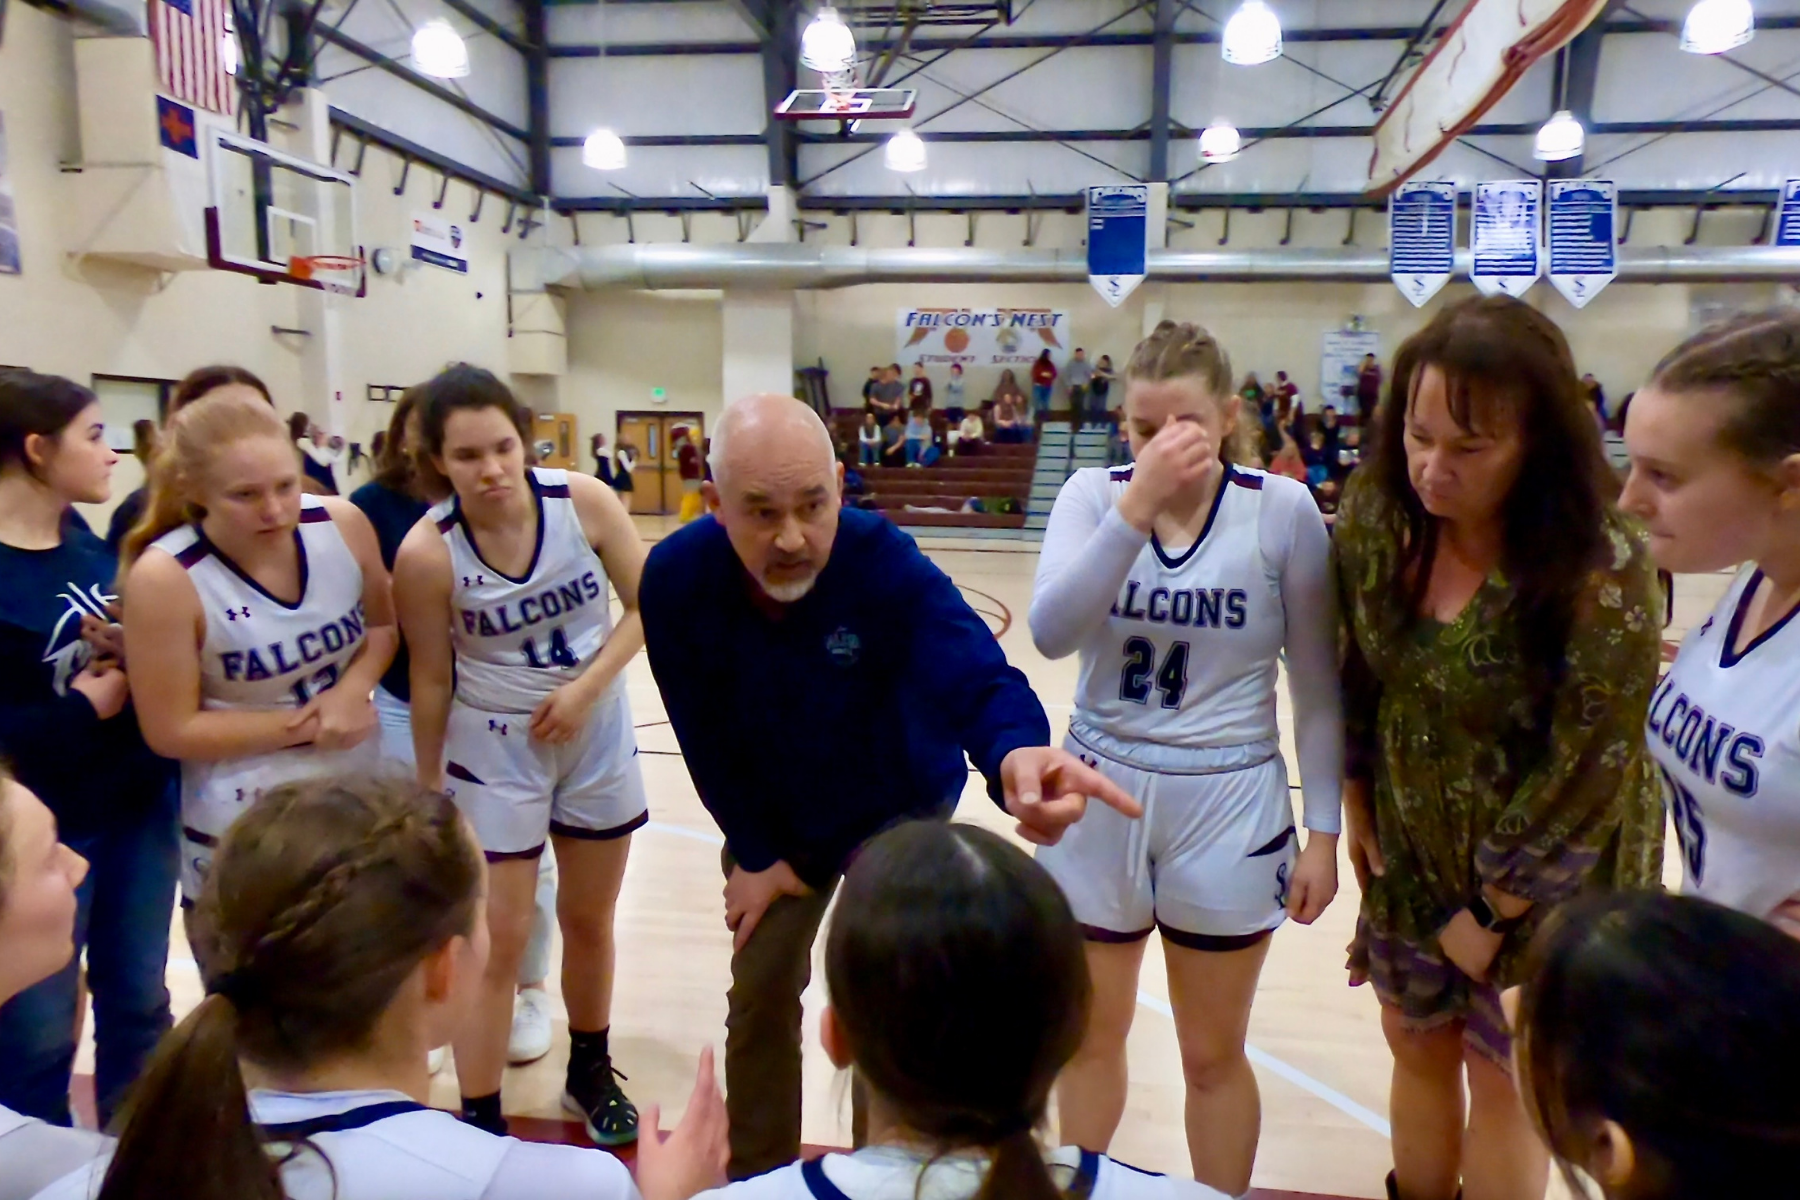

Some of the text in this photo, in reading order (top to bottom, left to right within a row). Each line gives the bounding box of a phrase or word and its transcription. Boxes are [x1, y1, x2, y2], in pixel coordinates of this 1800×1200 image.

[905, 312, 1063, 327] FALCON'S NEST
[991, 354, 1040, 364] SECTIO
[460, 570, 600, 637] FALCONS
[520, 624, 580, 669] 14
[1118, 635, 1191, 710] 24
[1649, 671, 1766, 799] LCONS
